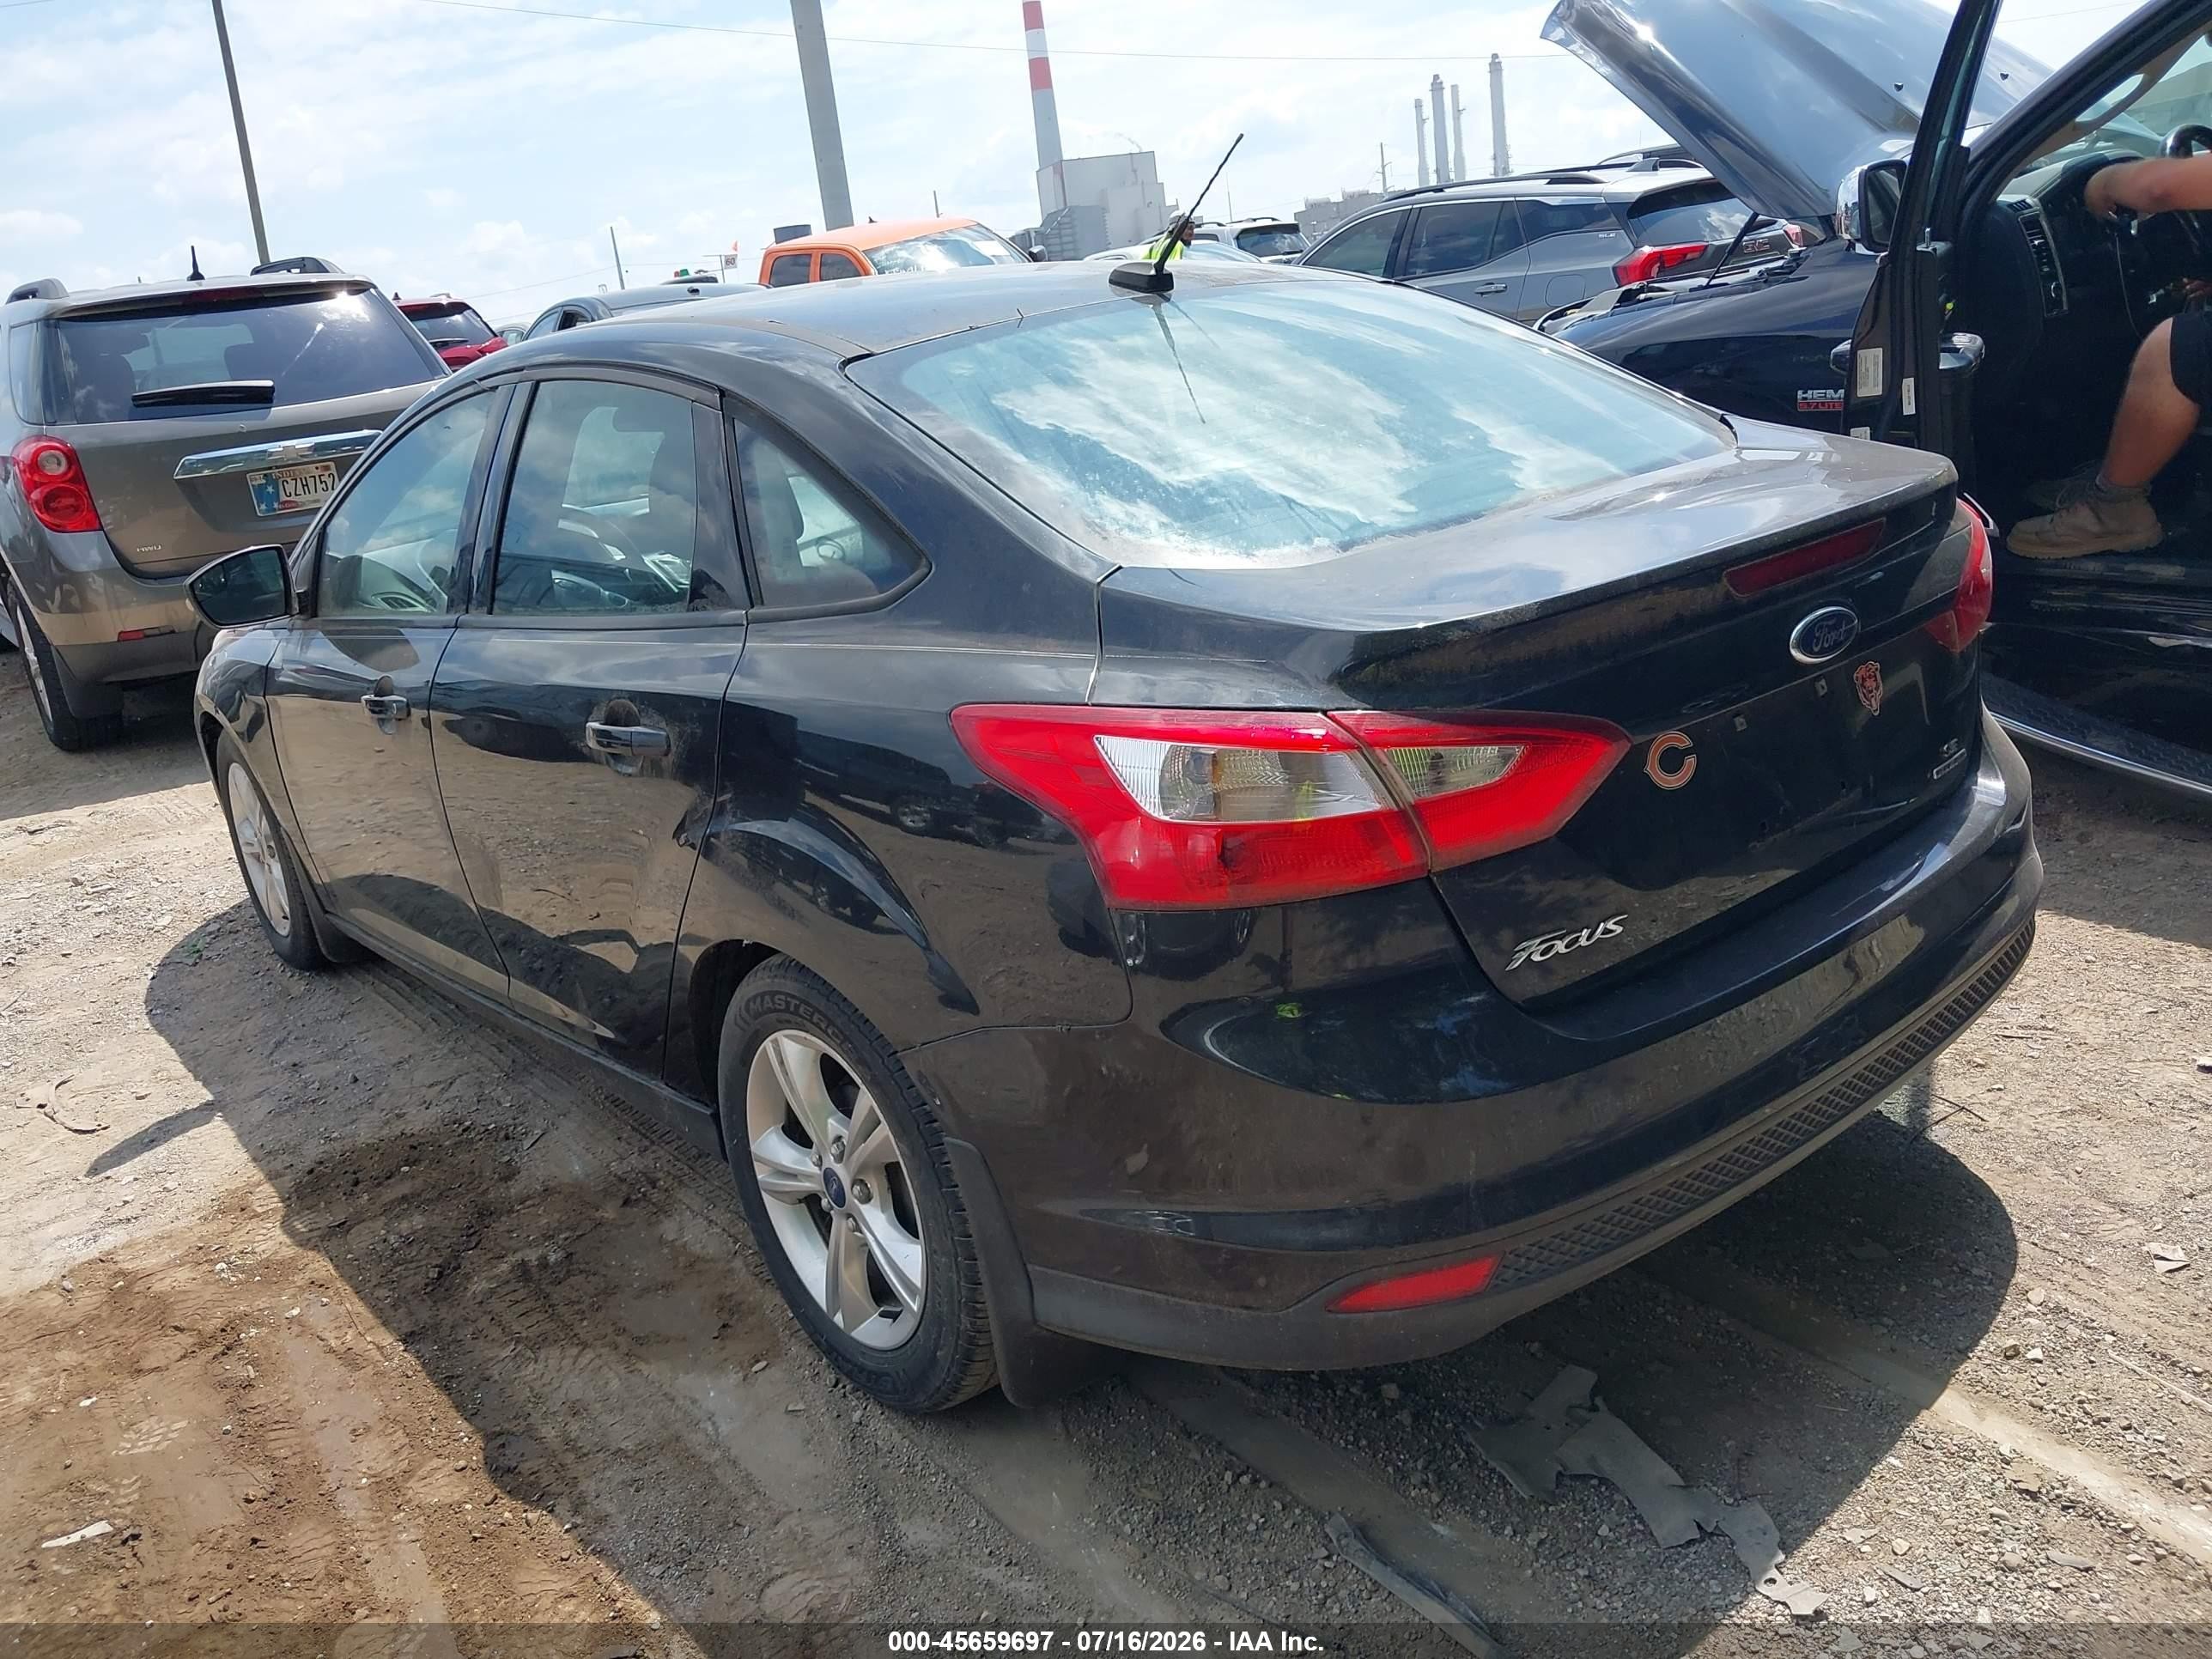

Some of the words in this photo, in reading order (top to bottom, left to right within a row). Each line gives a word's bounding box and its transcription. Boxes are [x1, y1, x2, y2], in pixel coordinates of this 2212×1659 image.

[726, 257, 736, 266] 60
[1797, 389, 1845, 400] HEM
[281, 472, 337, 498] CZH752
[1812, 618, 1847, 653] Ford
